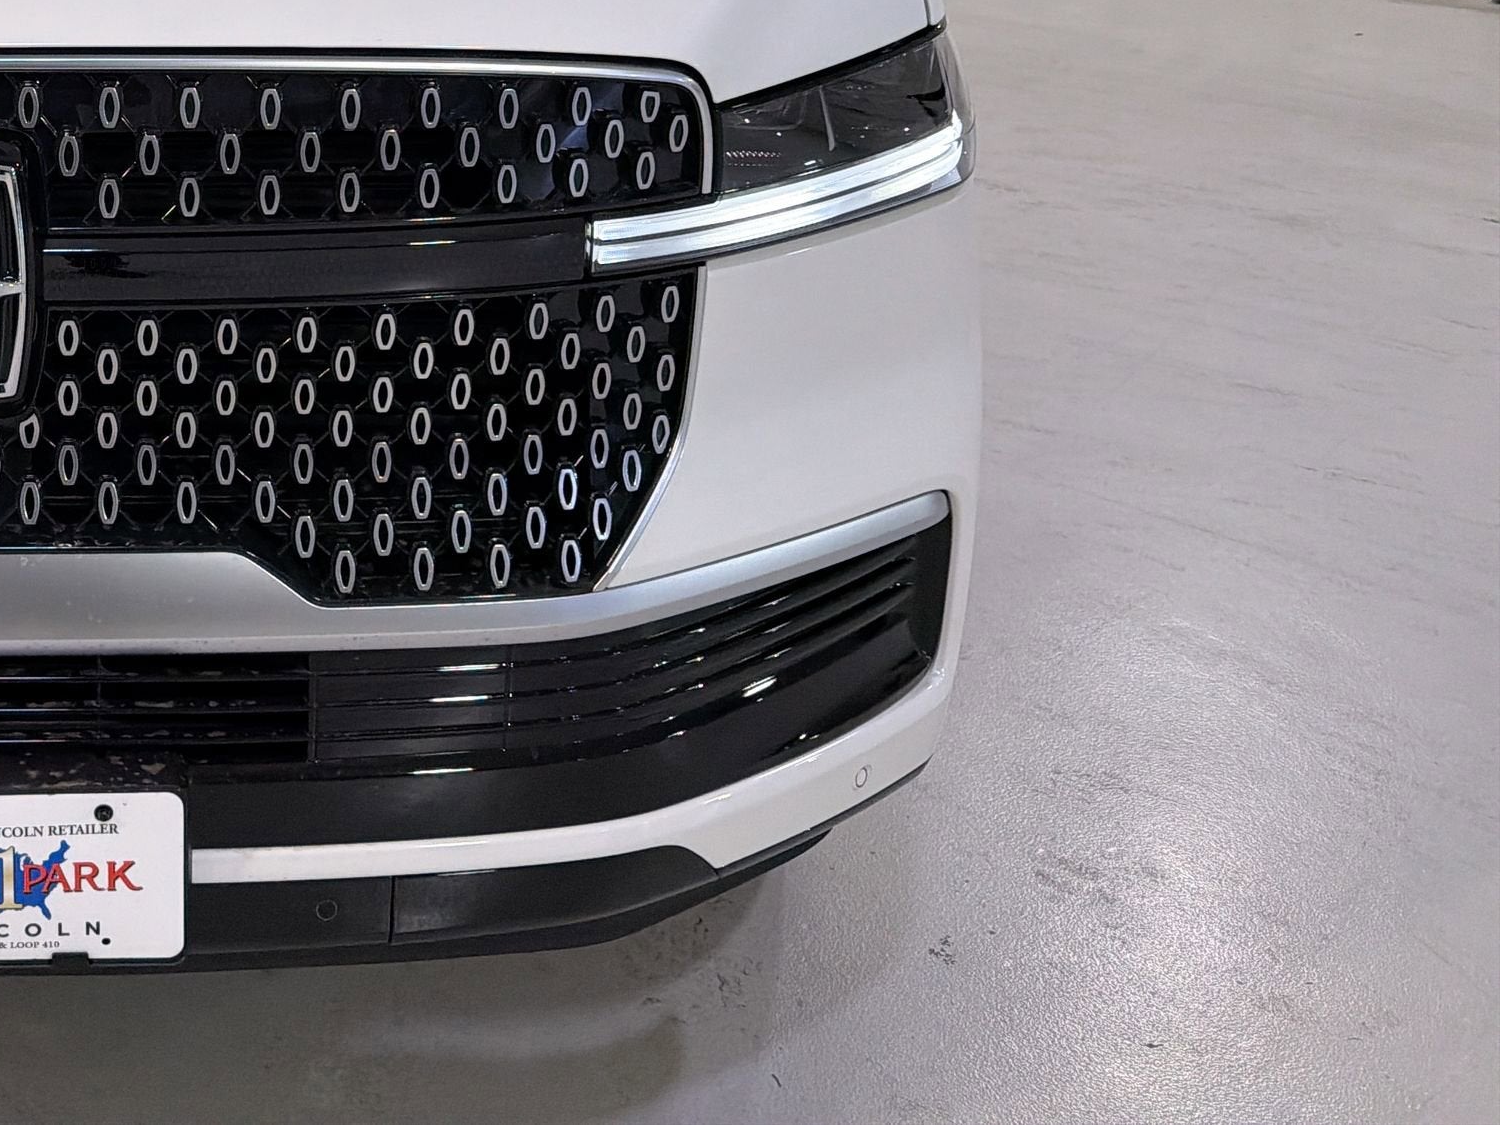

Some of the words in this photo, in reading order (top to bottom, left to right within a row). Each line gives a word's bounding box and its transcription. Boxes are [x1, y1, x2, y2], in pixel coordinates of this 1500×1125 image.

[48, 823, 119, 836] RETAILER
[23, 860, 143, 891] PARK
[0, 941, 8, 949] &
[11, 941, 39, 949] LOOP
[42, 940, 60, 948] 410
